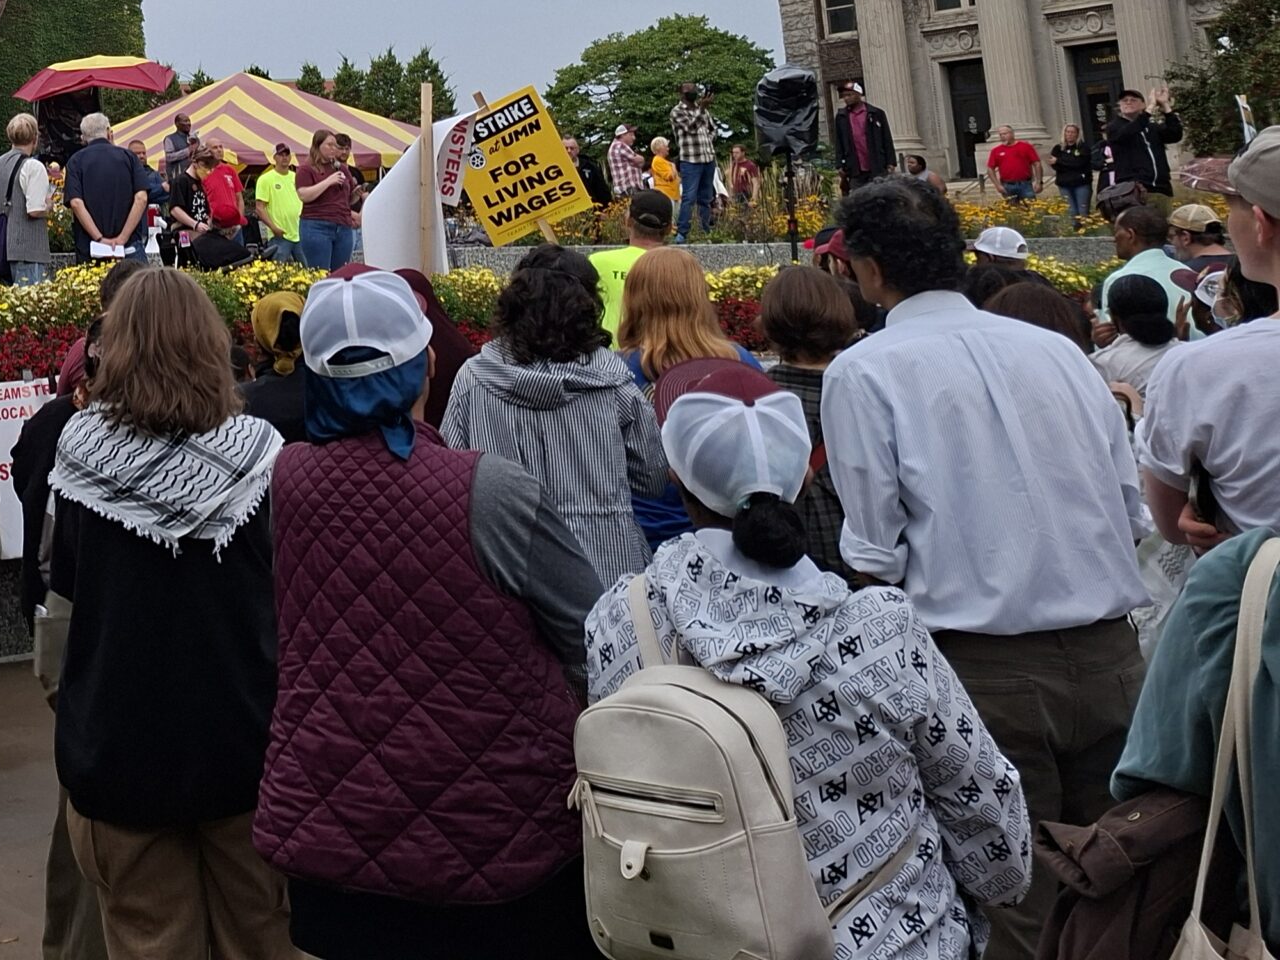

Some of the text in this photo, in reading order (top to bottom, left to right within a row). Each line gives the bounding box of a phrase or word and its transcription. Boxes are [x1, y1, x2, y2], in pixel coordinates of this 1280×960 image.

[475, 98, 535, 138] STRIKE
[489, 119, 542, 155] at UMN
[489, 152, 540, 184] FOR
[483, 165, 564, 209] LIVING
[488, 181, 577, 227] WAGES
[598, 642, 615, 672] A87
[837, 635, 864, 665] A87
[838, 656, 898, 707] AERO
[811, 690, 841, 722] A87
[789, 730, 854, 784] AERO
[819, 772, 848, 804] A87
[954, 775, 983, 806] A87
[856, 791, 884, 826] A87
[853, 804, 910, 868] AERO
[982, 835, 1012, 863] A87
[821, 853, 850, 885] A87
[870, 862, 920, 923] AERO
[848, 912, 878, 950] A87
